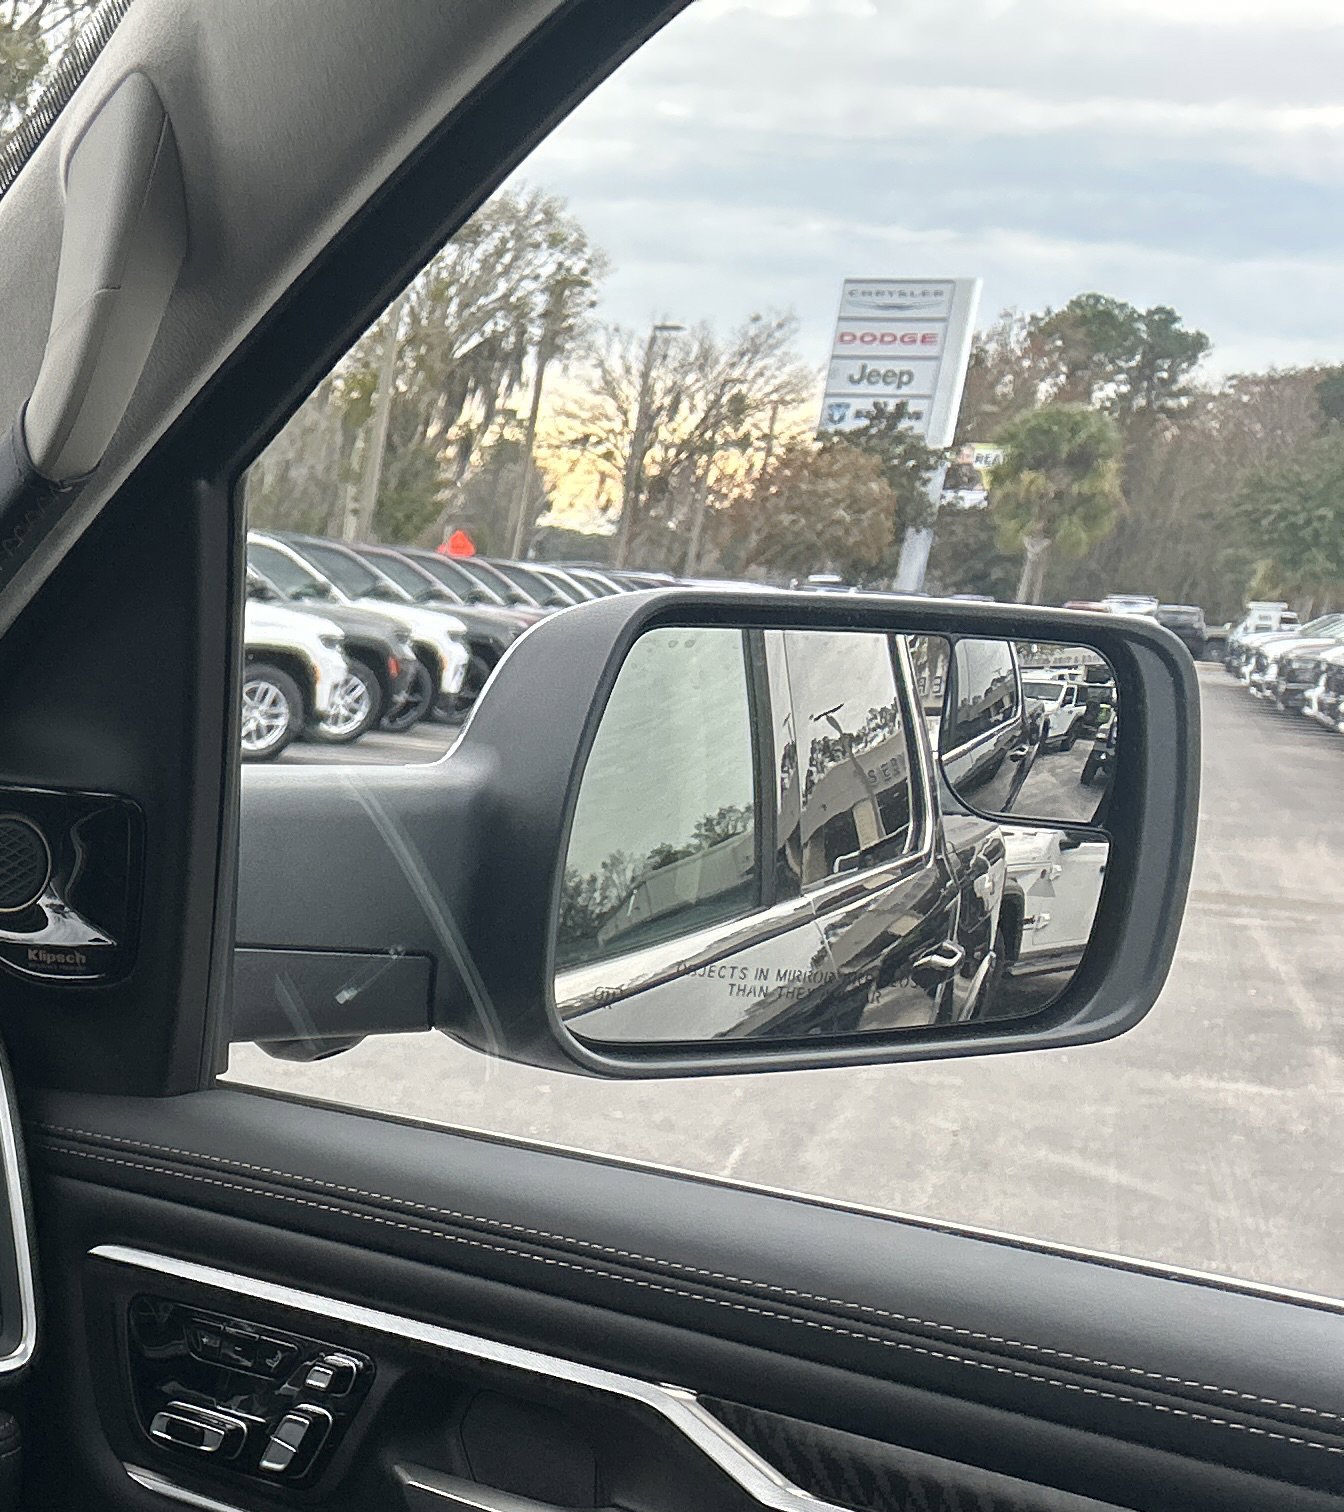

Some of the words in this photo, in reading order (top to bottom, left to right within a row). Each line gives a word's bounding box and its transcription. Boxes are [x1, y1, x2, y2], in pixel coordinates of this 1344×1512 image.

[848, 289, 944, 298] CHRYSLER
[838, 331, 939, 346] DODGE
[848, 363, 915, 390] Jeep
[28, 949, 87, 964] Klipsch
[754, 967, 769, 982] IN
[728, 983, 768, 998] THAN
